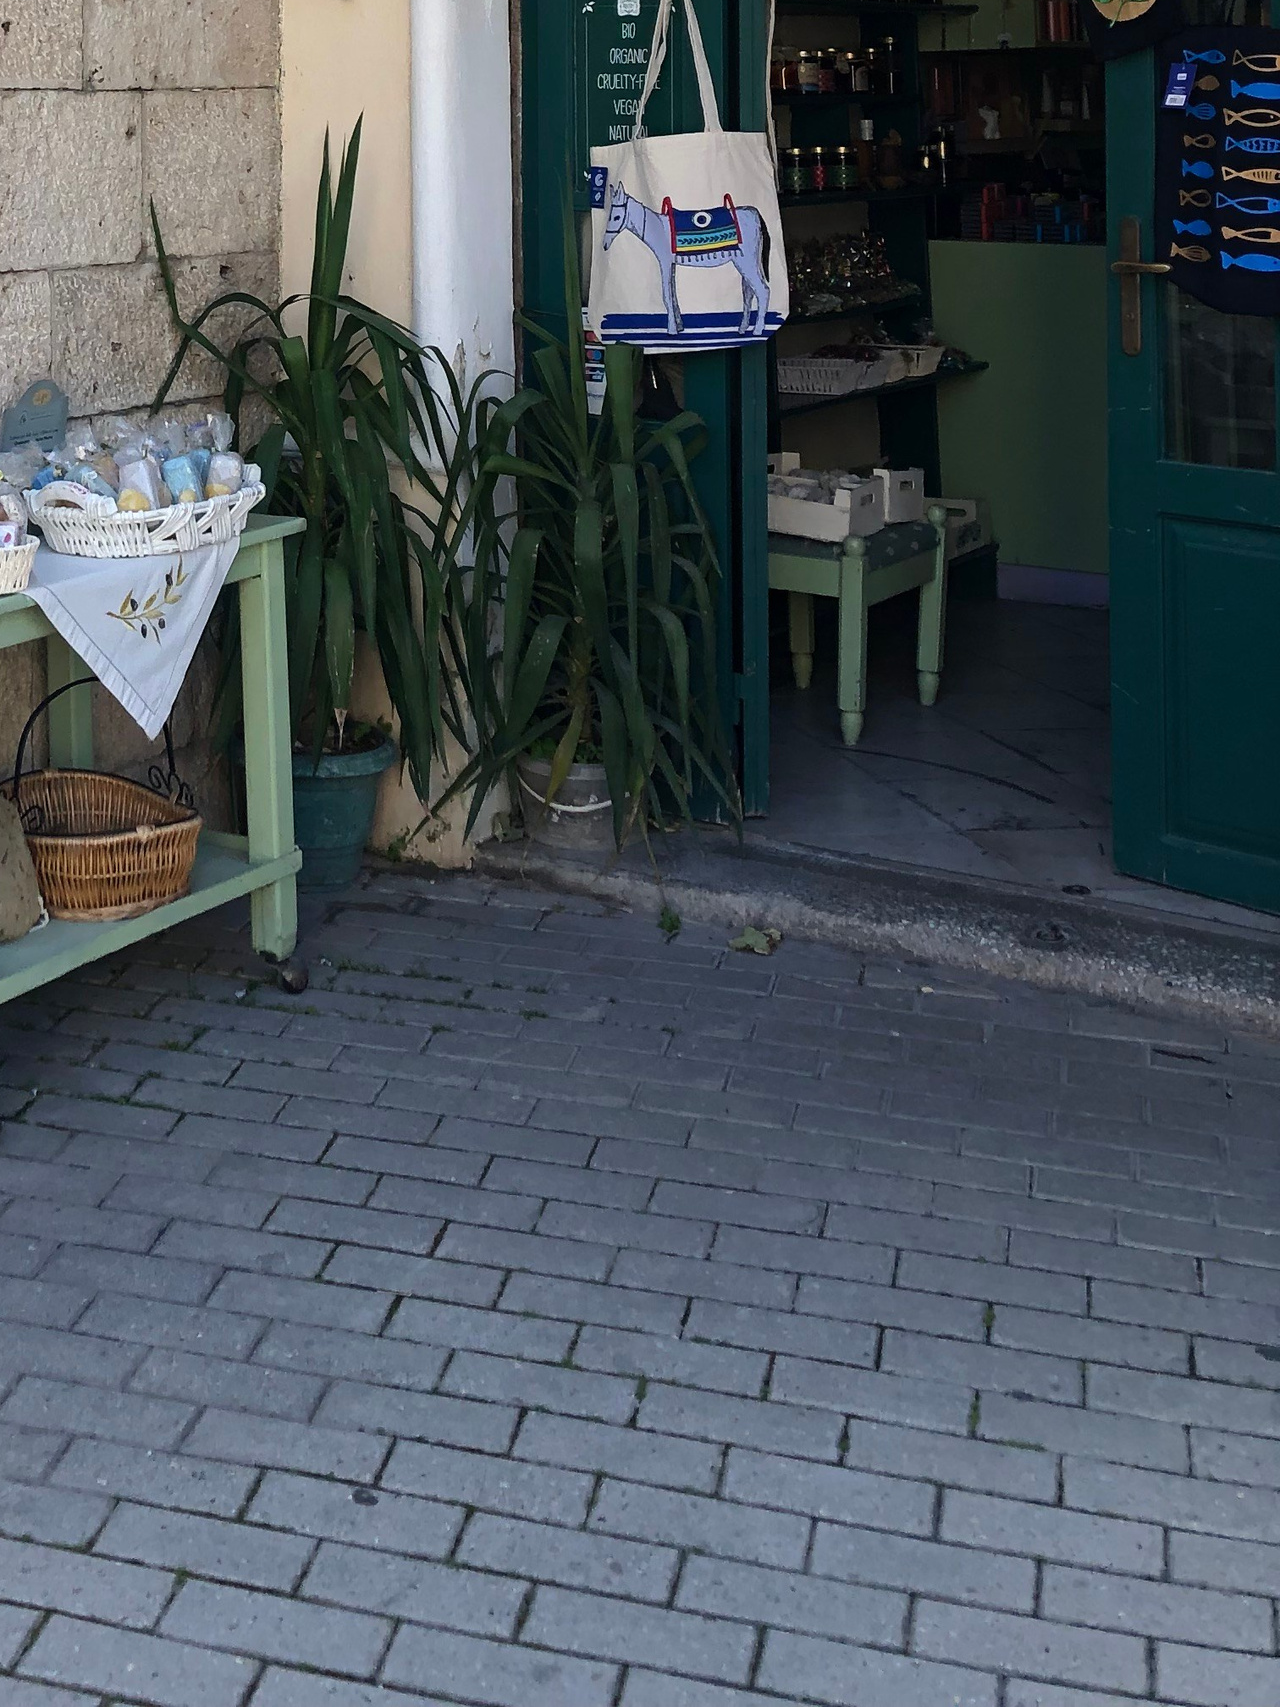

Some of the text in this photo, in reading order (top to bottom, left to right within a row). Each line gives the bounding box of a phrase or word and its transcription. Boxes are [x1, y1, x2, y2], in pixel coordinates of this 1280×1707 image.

[621, 22, 636, 39] BIO
[609, 48, 649, 64] ORGANIC
[597, 73, 661, 90] CRUELTY-FE
[608, 125, 649, 141] NATUAL
